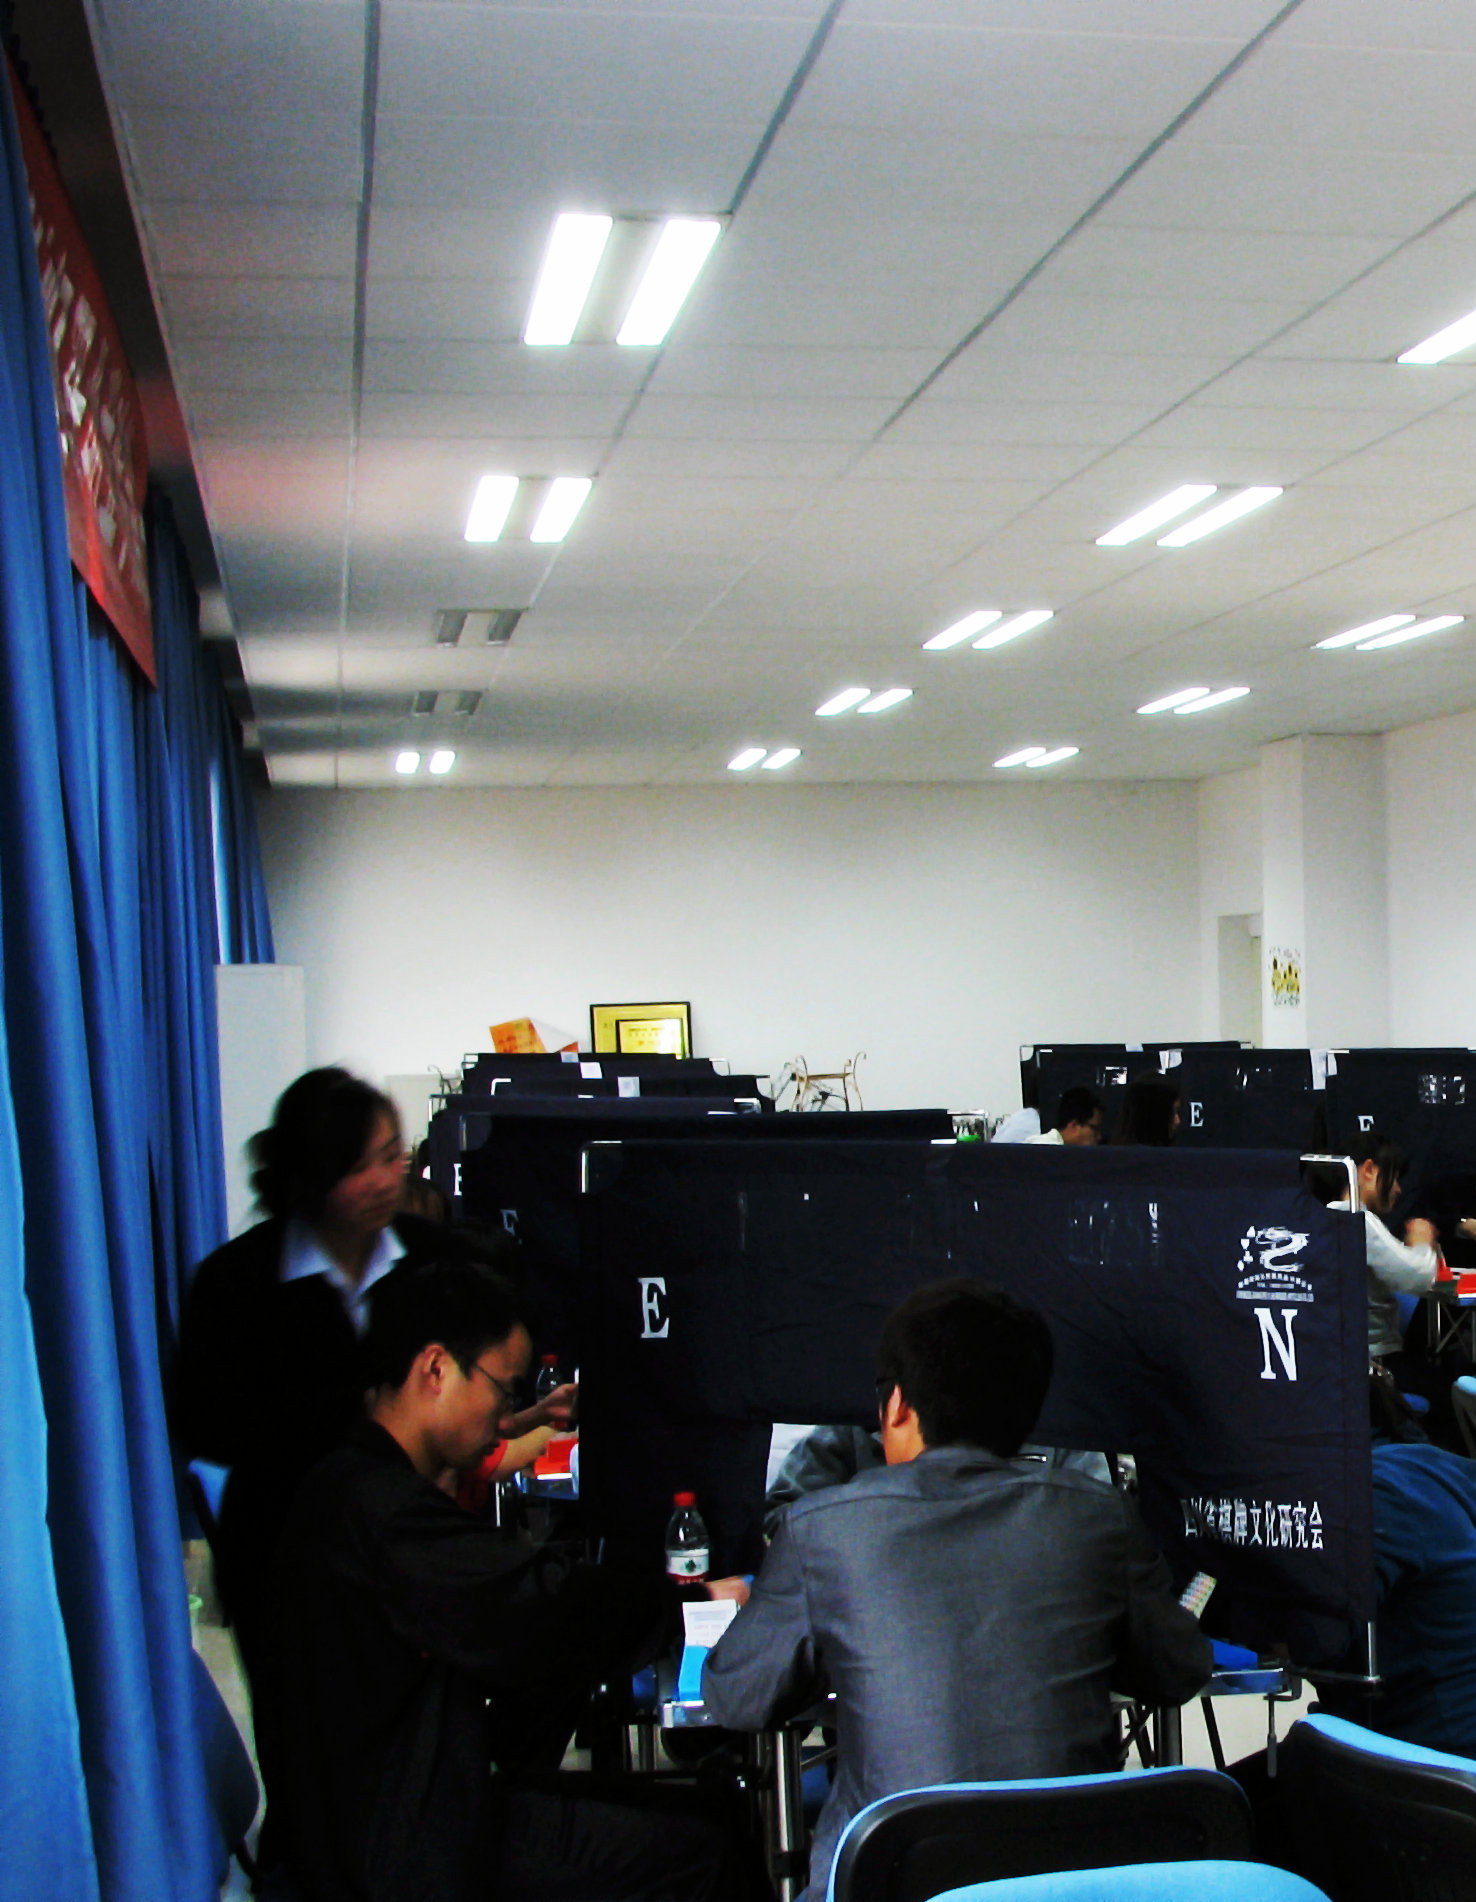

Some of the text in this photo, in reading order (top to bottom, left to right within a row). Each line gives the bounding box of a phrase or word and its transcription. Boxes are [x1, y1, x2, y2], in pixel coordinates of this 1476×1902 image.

[1189, 1101, 1204, 1128] E
[639, 1277, 670, 1339] E
[1253, 1307, 1298, 1382] N
